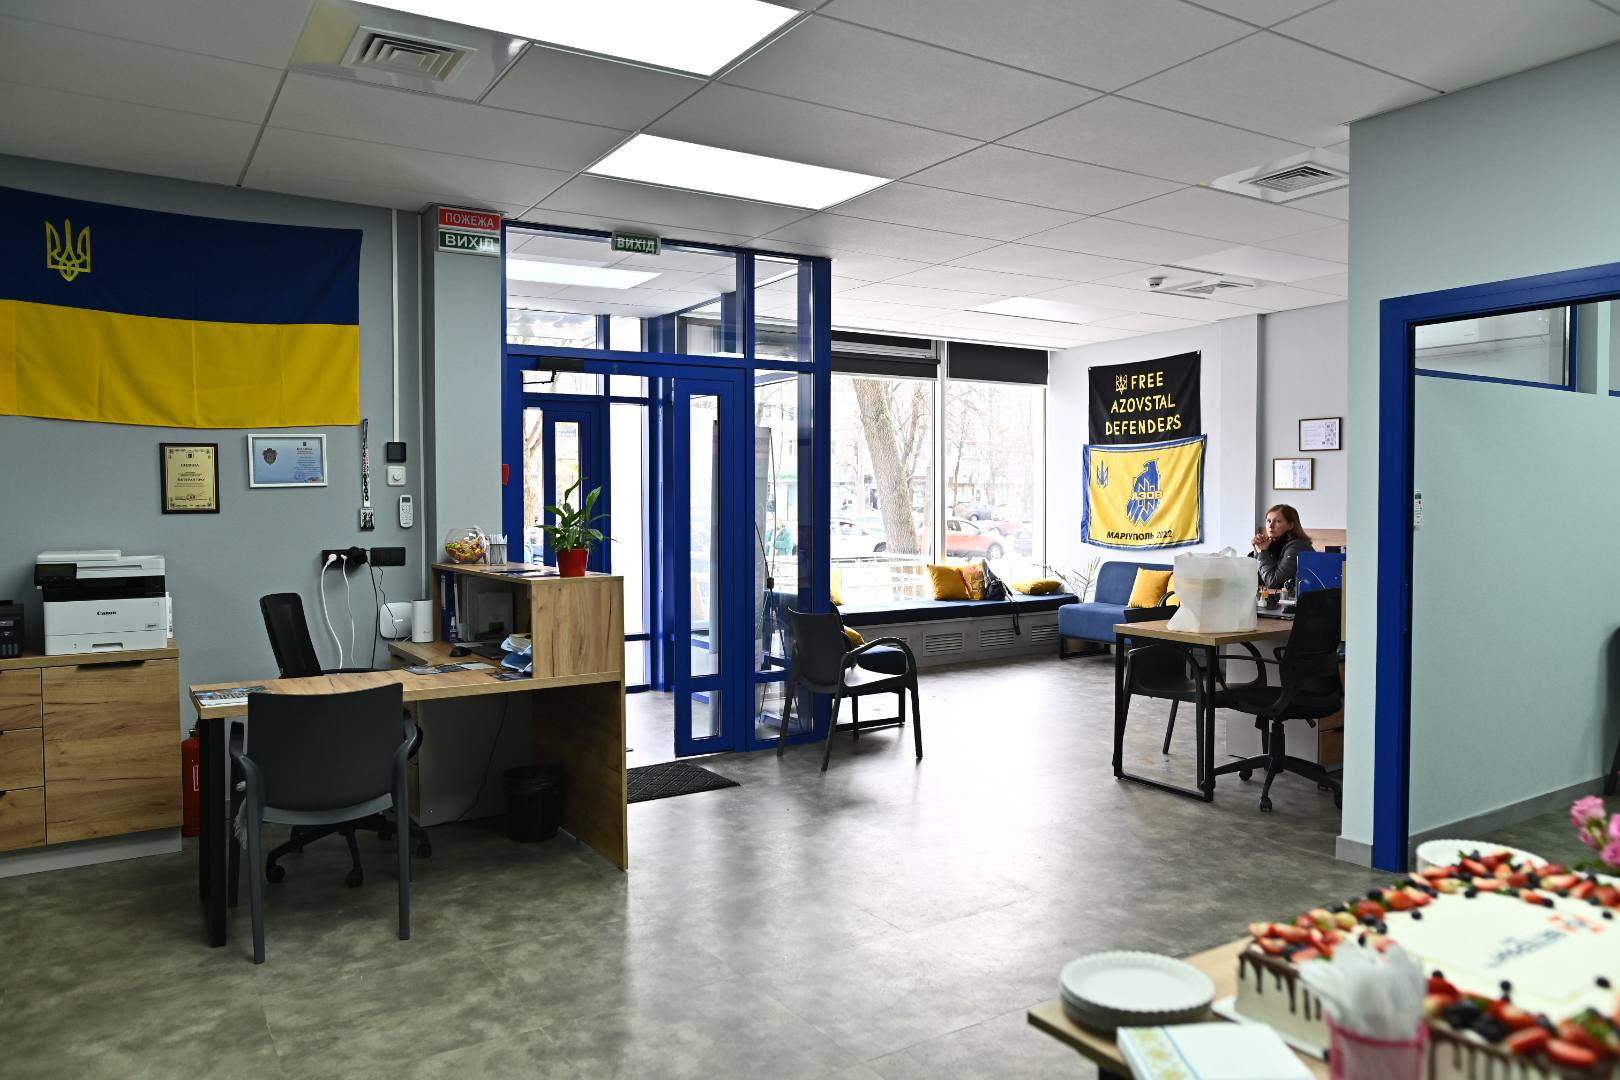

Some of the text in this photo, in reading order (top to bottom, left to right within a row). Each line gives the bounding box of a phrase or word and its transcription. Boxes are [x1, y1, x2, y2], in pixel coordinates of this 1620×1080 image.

[446, 212, 494, 228] ПОЖЕЖА
[445, 234, 494, 251] ВИХІД
[617, 237, 655, 254] ВИХІД
[1131, 372, 1163, 390] FREE
[1110, 393, 1175, 413] AZOVSTAL
[1105, 414, 1182, 435] DEFENDERS
[1106, 531, 1154, 540] МАРІУПОЛЬ
